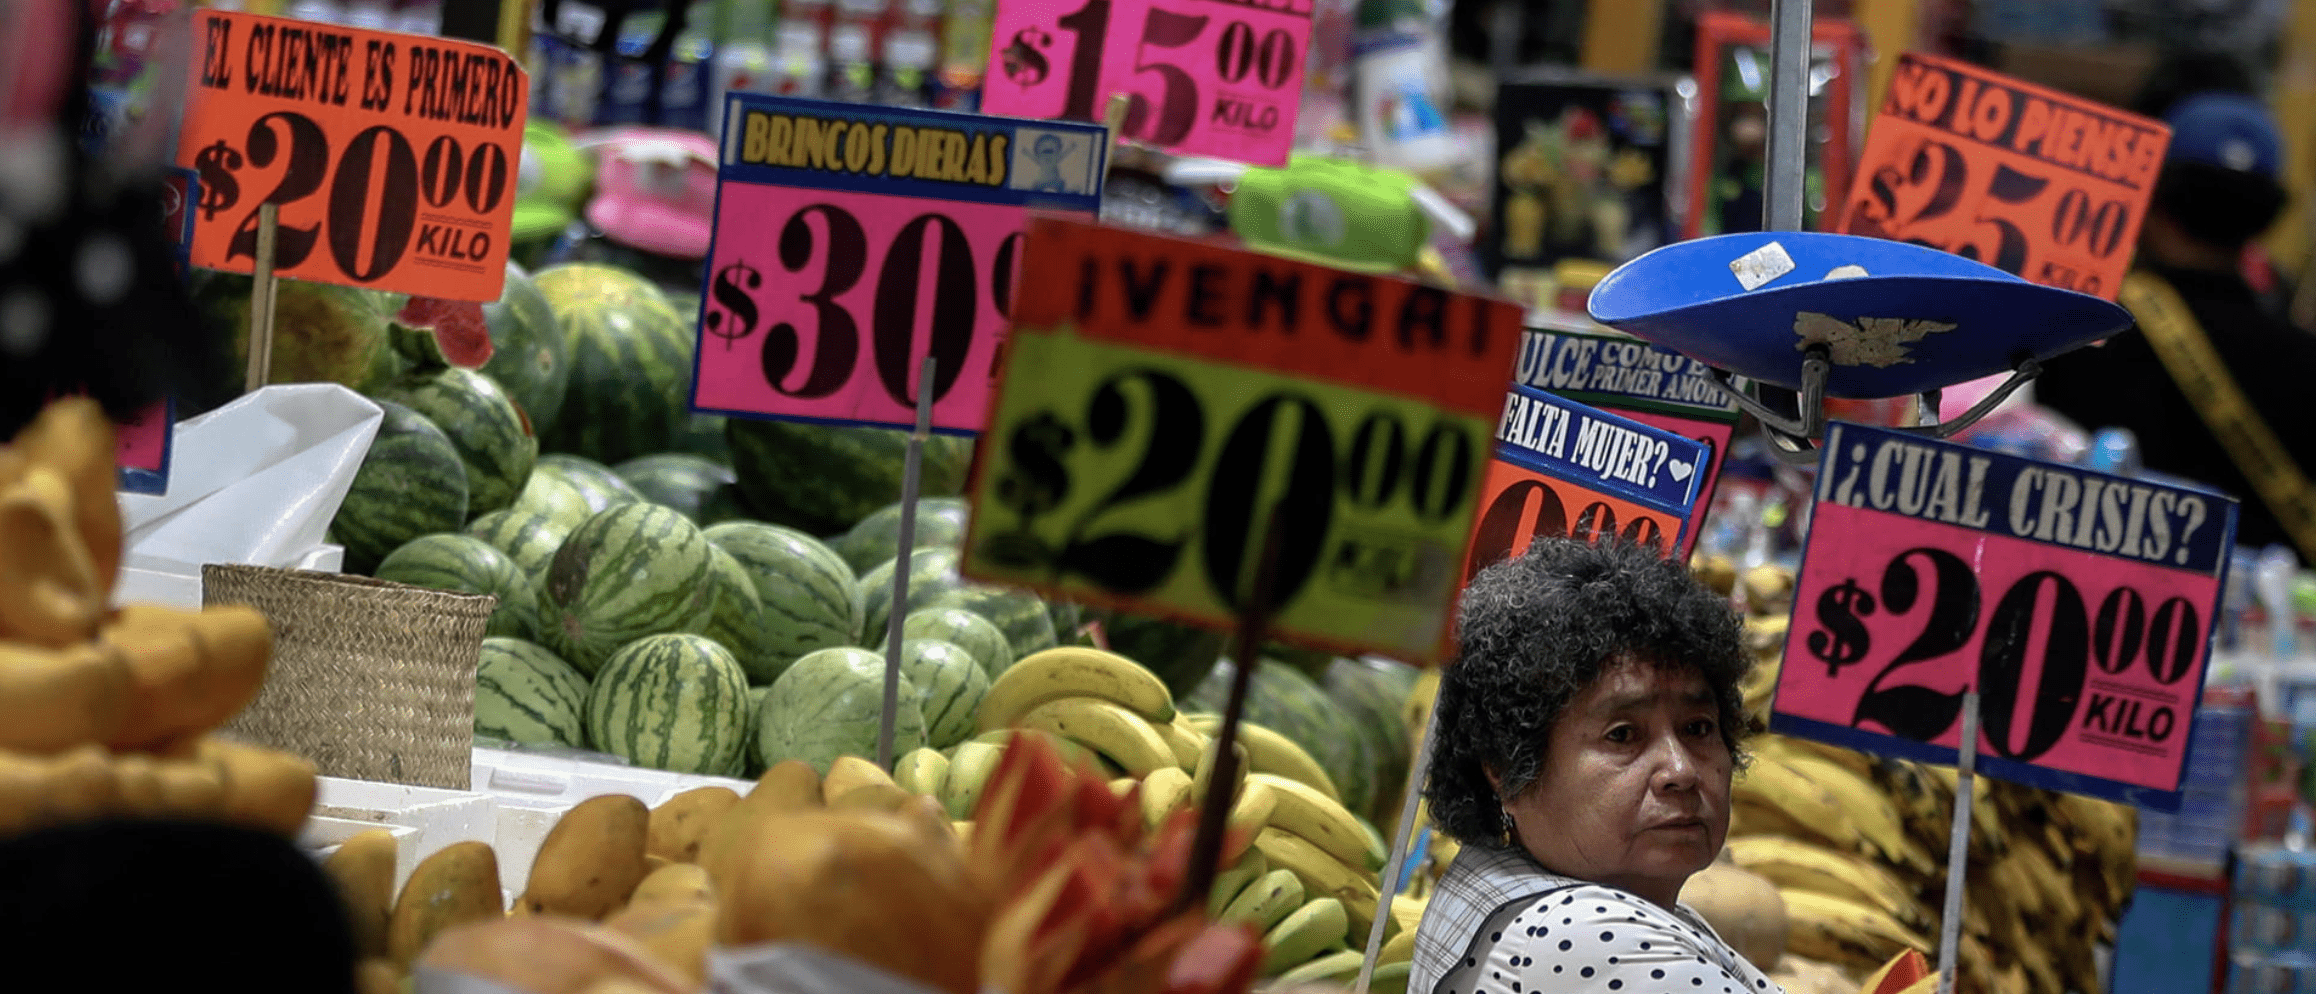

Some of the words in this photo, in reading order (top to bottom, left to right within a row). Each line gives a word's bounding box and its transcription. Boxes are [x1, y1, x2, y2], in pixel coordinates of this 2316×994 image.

[201, 17, 232, 90] EL
[245, 23, 352, 107] CLIENTE
[360, 40, 396, 112] ES
[404, 46, 518, 130] PRIMERO
[1211, 98, 1279, 131] KILO
[1952, 78, 2012, 142] LO
[2014, 97, 2160, 182] PIENSE
[742, 111, 888, 176] BRINCOS
[890, 126, 1008, 187] DIERAS
[417, 224, 491, 262] KILO
[1515, 331, 1598, 390] ULCE
[1601, 341, 1685, 374] COMO
[1589, 364, 1662, 398] PRIMER
[1496, 391, 1571, 459] FALTA
[1570, 415, 1669, 489] MUJER?
[1835, 440, 1992, 528] ¿CUAL
[2009, 467, 2208, 565] CRISIS?
[2082, 694, 2177, 742] KILO
